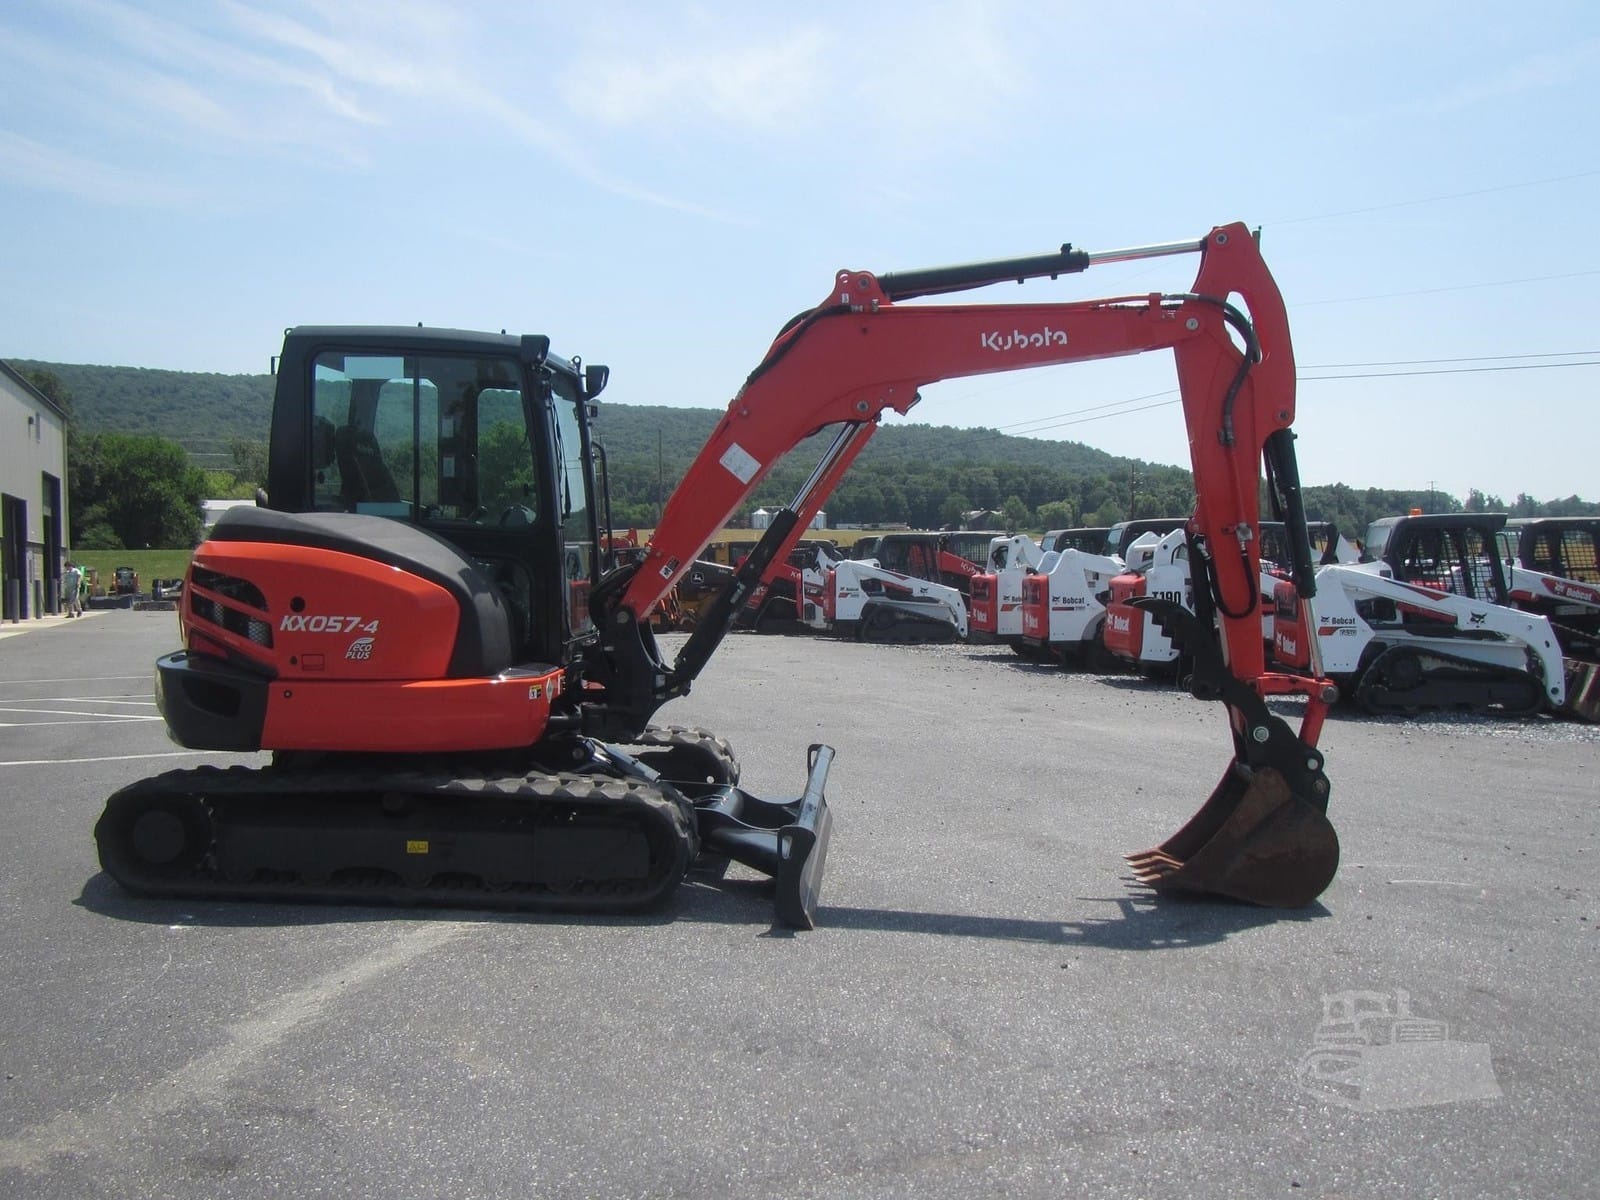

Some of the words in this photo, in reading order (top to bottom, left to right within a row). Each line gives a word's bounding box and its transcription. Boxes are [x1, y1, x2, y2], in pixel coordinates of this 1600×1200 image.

[981, 326, 1067, 351] Kubota
[280, 615, 379, 633] KX057-4
[1331, 617, 1356, 625] Bobcat
[353, 644, 373, 652] eco
[345, 652, 371, 660] PLUS
